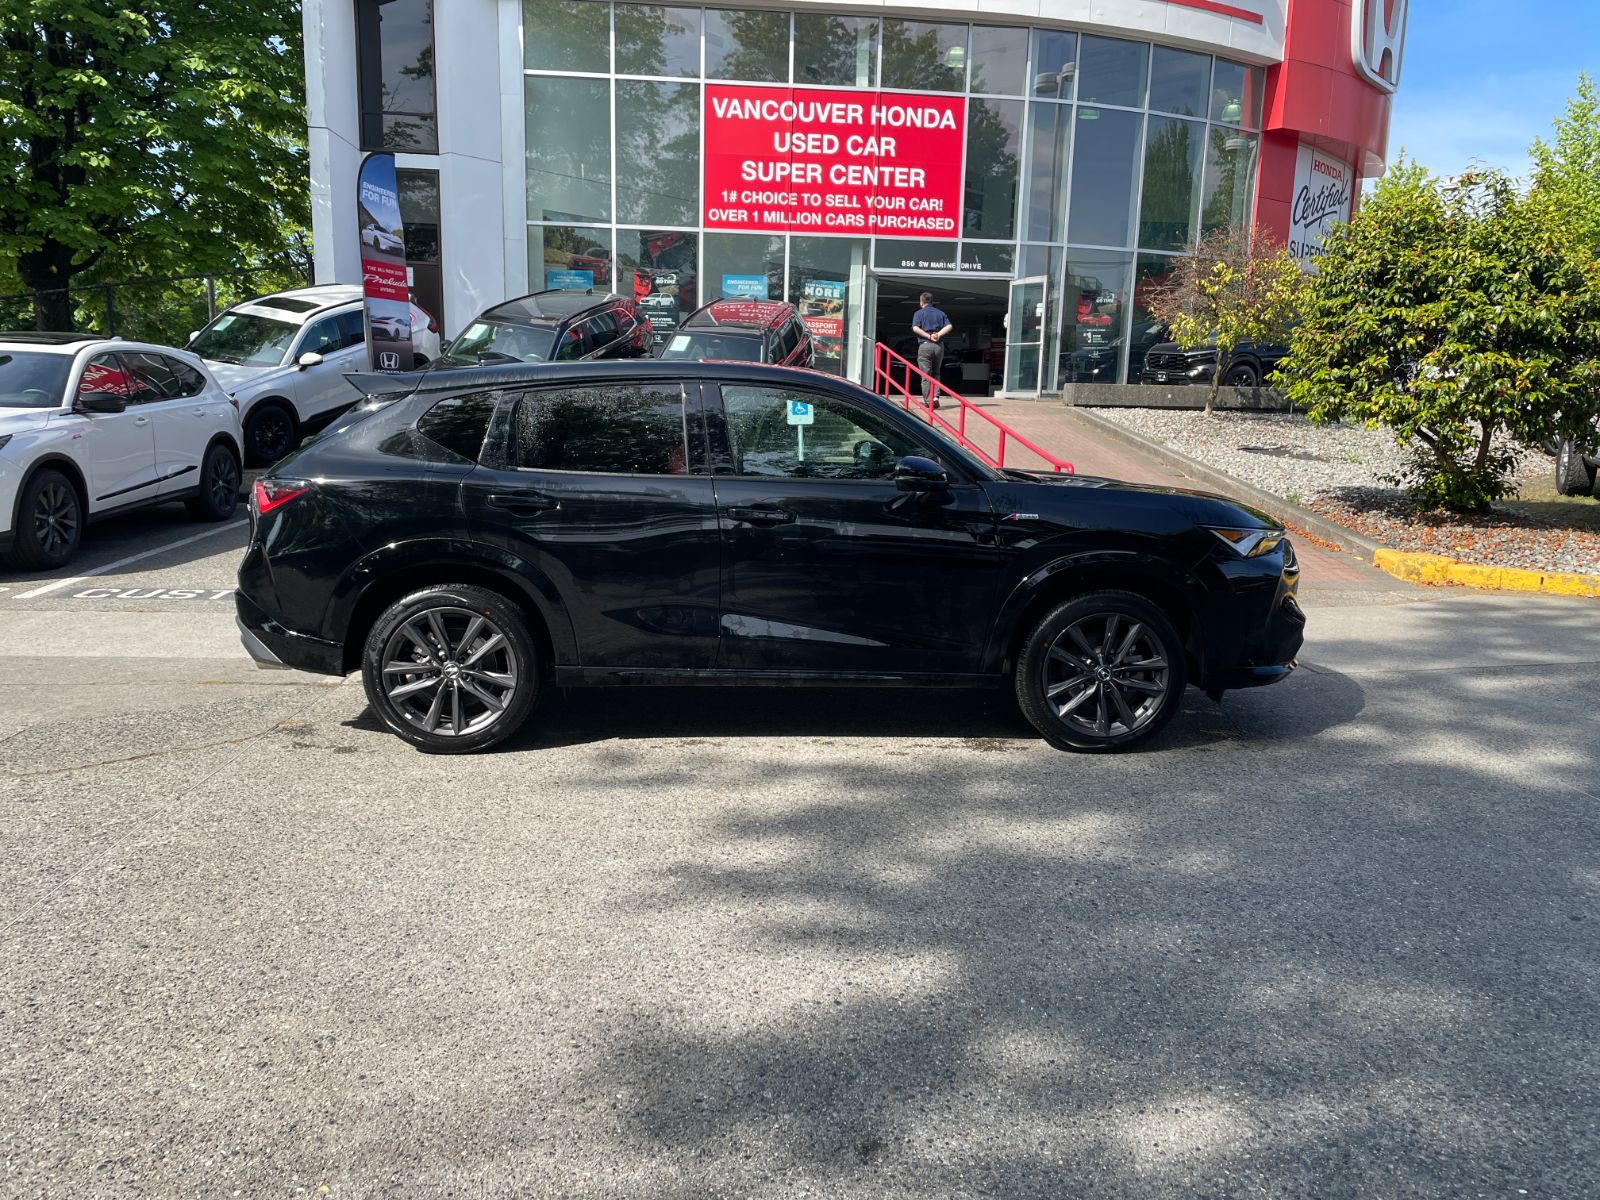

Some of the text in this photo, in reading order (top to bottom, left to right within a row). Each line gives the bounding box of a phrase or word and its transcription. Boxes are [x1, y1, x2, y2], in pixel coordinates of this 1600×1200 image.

[711, 97, 957, 129] VANCOUVER HONDA
[773, 131, 896, 157] USED CAR
[741, 160, 925, 188] SUPER CENTER
[1313, 159, 1342, 181] HONDA
[362, 181, 396, 199] ENGINEERED
[362, 188, 398, 209] FOR FUN
[721, 189, 943, 211] 1# CHOICE TO SELL YOUR CAR!
[1292, 178, 1348, 228] Certified
[708, 208, 955, 230] OVER 1 MILLION CARS PURCHASED
[363, 273, 408, 287] Prelude
[804, 286, 840, 298] MORE
